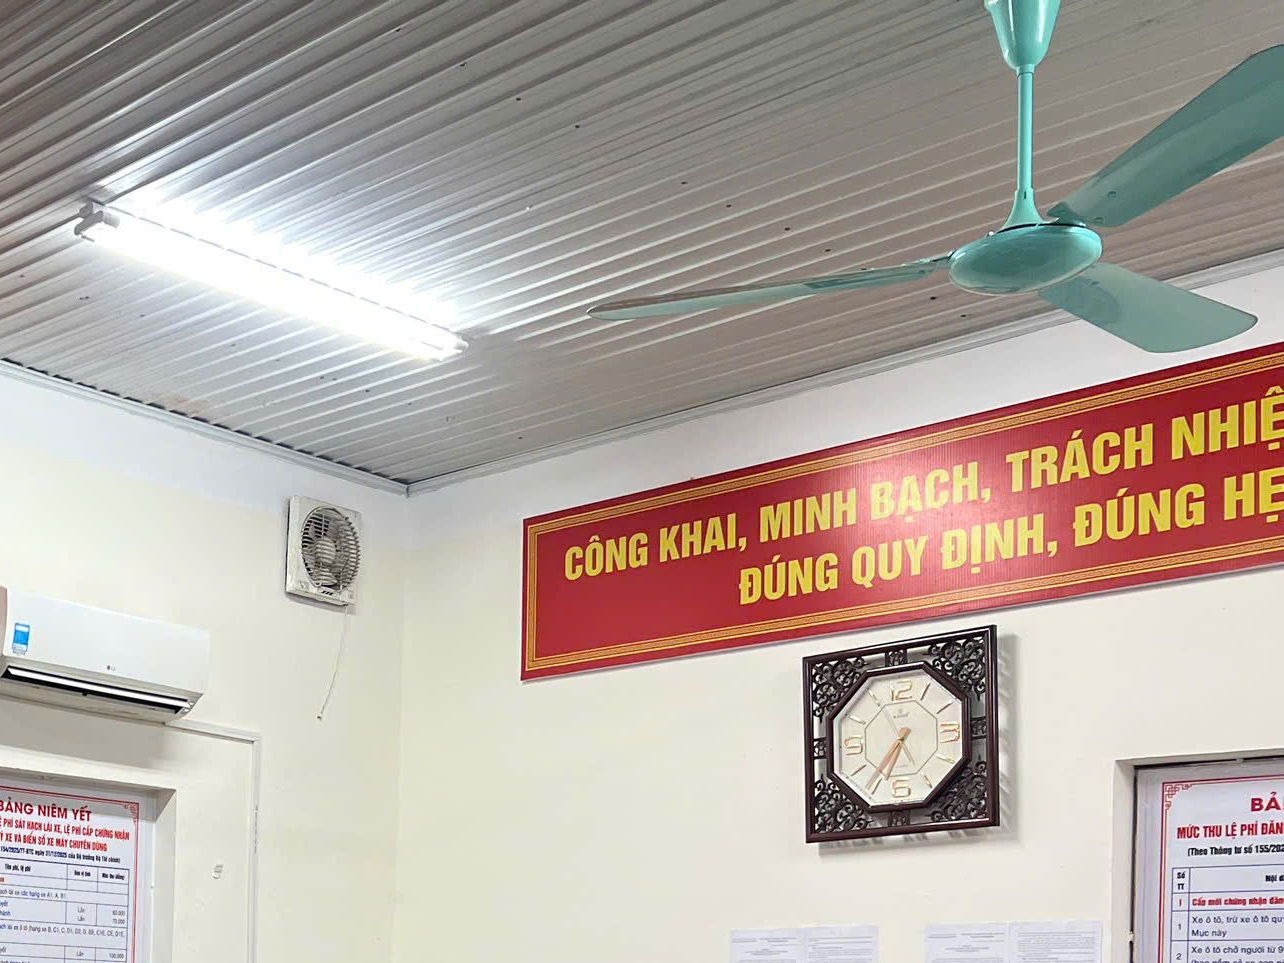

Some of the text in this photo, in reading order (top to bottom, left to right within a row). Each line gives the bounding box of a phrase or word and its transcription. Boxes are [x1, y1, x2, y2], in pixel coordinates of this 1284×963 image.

[564, 386, 1284, 581] CÔNG KHAI, MINH BẠCH, TRÁCH NHIỆ
[738, 467, 1284, 606] ĐÚNG QUY ĐỊNH, ĐÚNG HẸ
[1251, 791, 1281, 812] BẢ
[37, 803, 68, 819] NIÊM
[71, 805, 92, 822] YẾT
[1177, 820, 1284, 839] MỨC THU LỆ PHÍ ĐĂN
[1244, 844, 1253, 854] số
[1205, 916, 1211, 924] ô
[1213, 916, 1224, 924] tô,
[1253, 915, 1259, 923] ô
[1261, 915, 1269, 923] tô
[1191, 929, 1227, 938] Mục này
